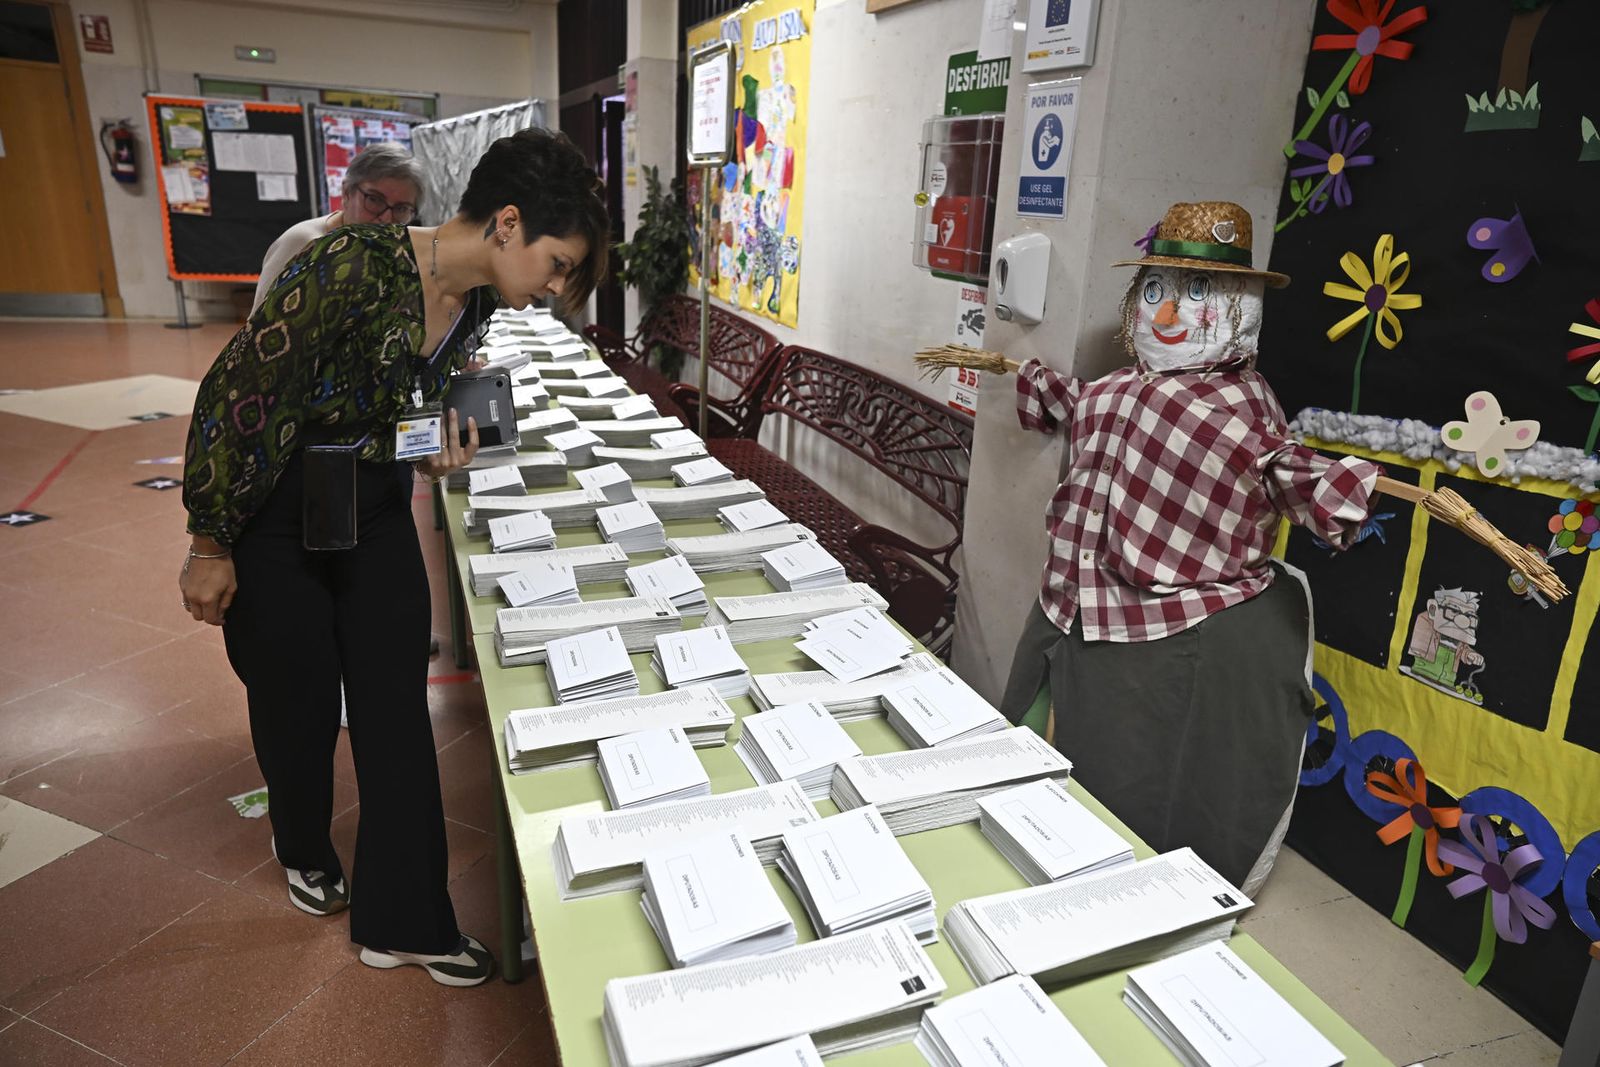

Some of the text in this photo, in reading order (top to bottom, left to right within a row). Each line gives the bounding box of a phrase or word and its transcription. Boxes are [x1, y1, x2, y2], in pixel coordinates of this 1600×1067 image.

[948, 60, 1009, 93] DESFIBRIL
[1031, 92, 1074, 108] POR FAVOR
[1030, 184, 1053, 193] USE GEL
[1018, 196, 1064, 207] DESINFECTANTE
